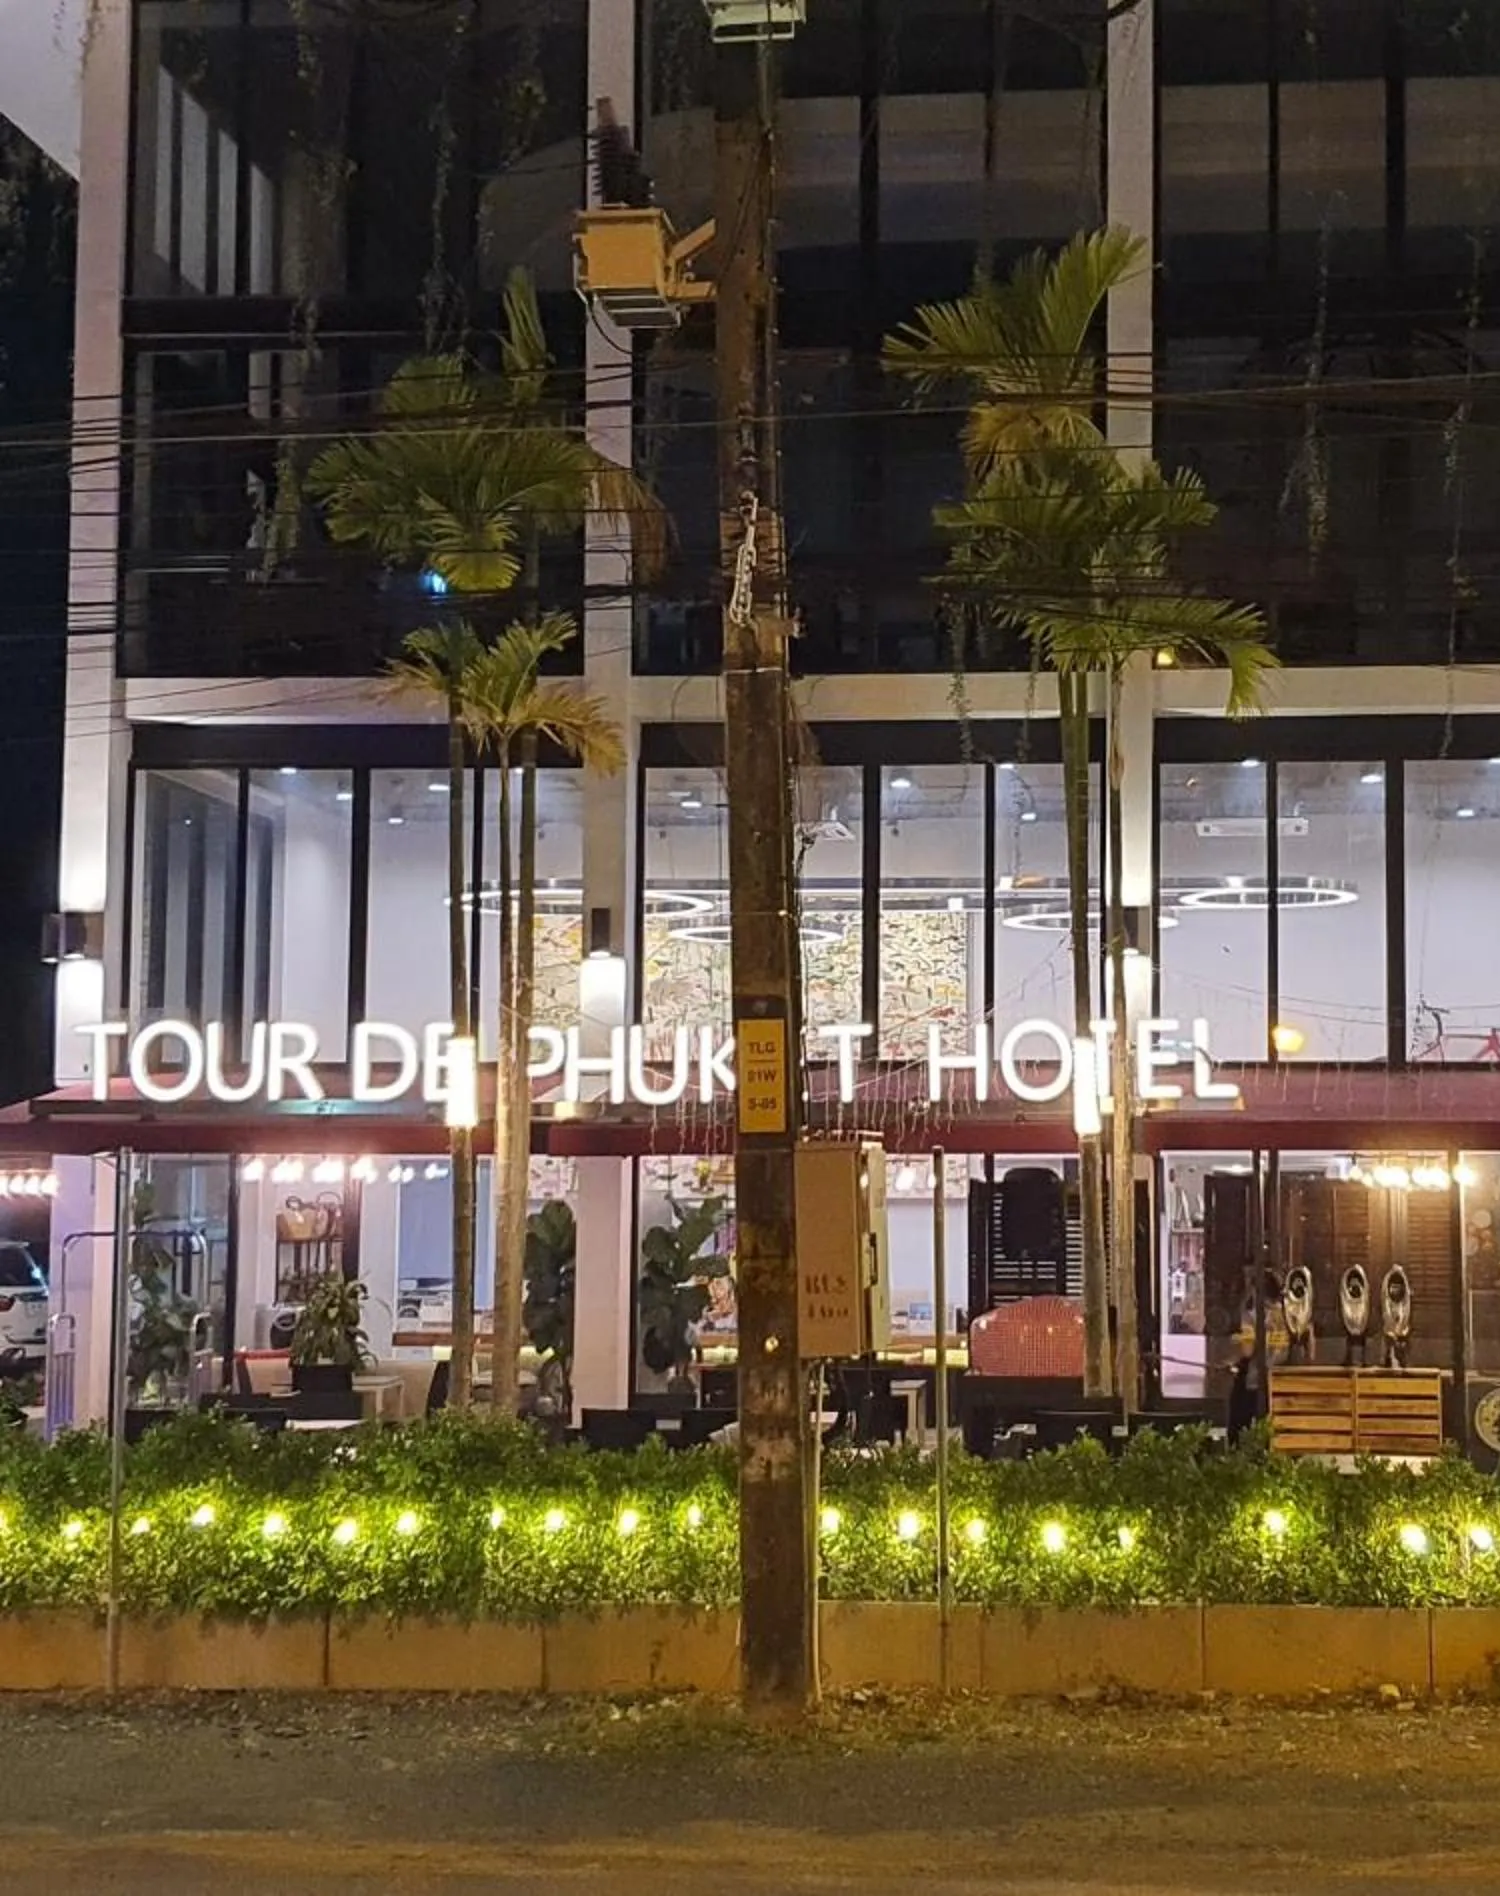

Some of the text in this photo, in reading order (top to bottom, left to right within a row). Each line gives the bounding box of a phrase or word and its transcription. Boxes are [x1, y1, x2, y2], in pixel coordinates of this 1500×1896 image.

[74, 1018, 1240, 1104] TOUR DE PHUKT HOTEL
